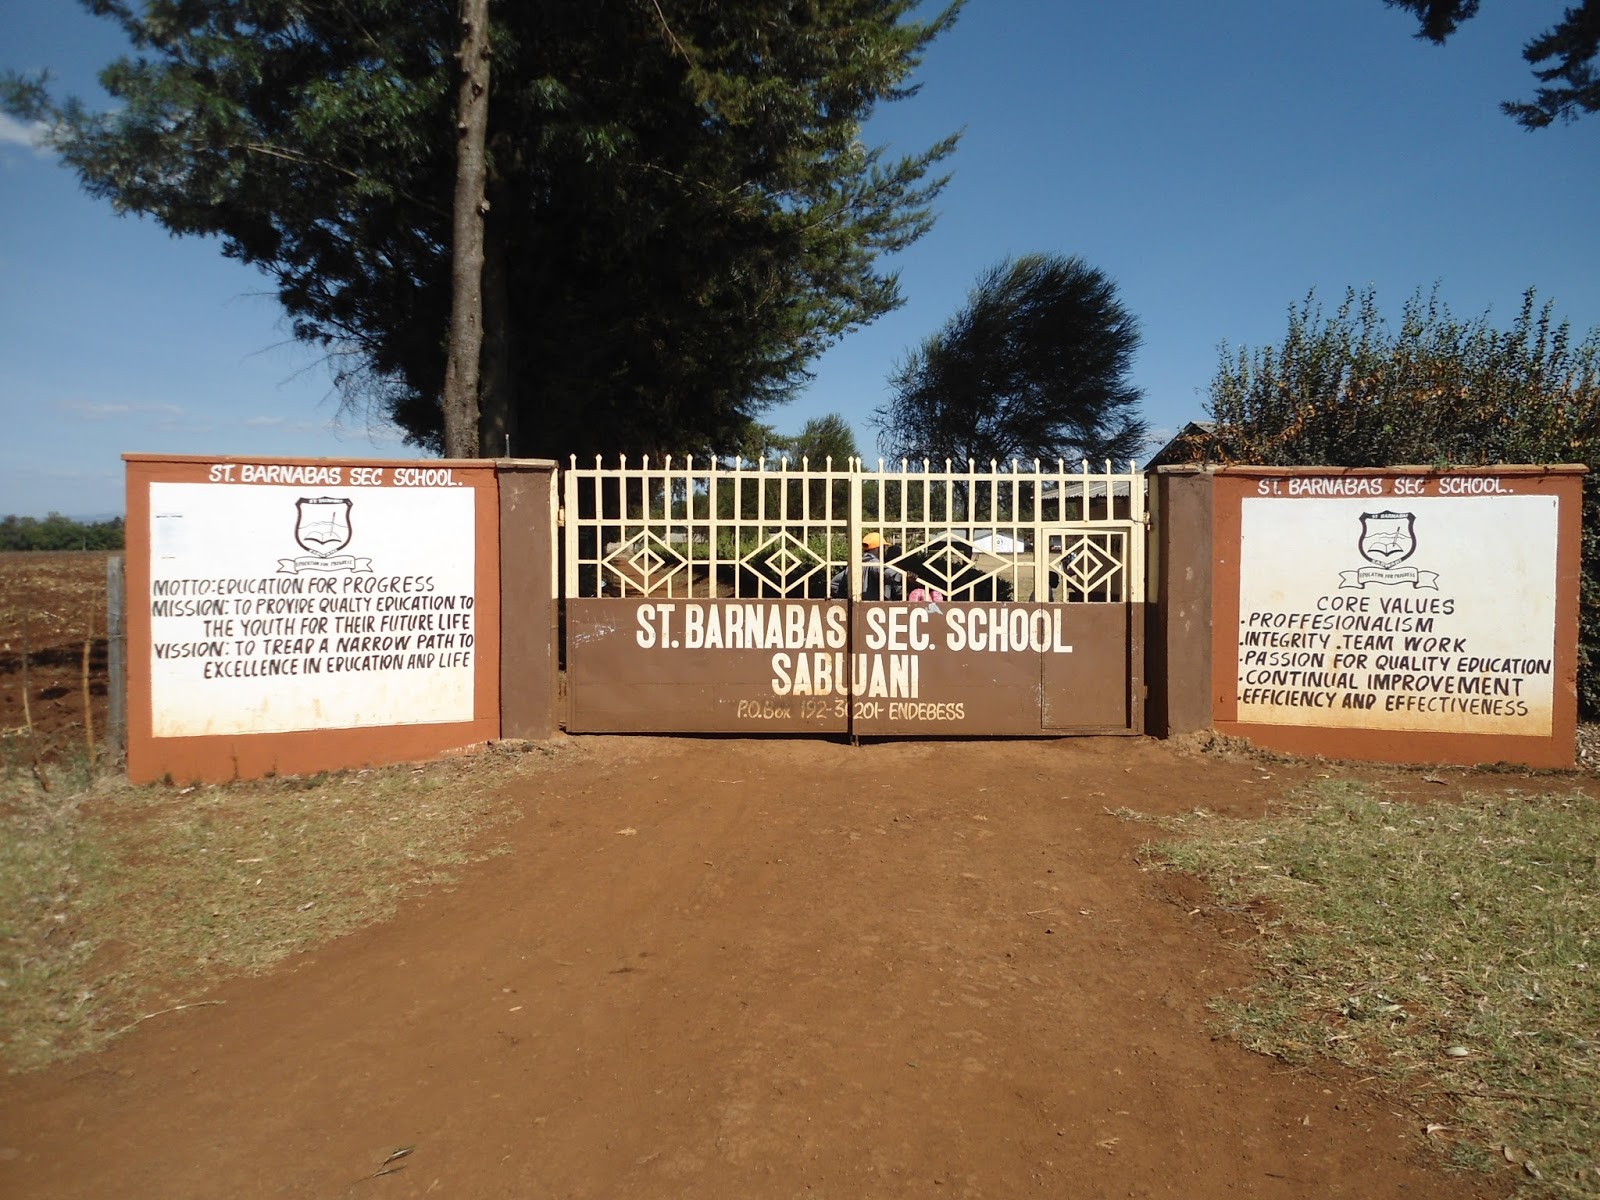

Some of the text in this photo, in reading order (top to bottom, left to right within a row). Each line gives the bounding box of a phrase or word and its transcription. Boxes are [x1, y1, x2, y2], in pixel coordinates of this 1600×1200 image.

[208, 465, 463, 487] ST. BARNABAS SEC SCHOOL.
[1257, 477, 1514, 495] ST. BARNABAS SEC SCHOOL.
[308, 577, 337, 595] FOR
[343, 576, 435, 594] PROGRESS
[152, 595, 474, 617] MISSION: TO PROVIDE QUALTY EDUCATION TO
[1316, 596, 1455, 615] CORE VALUES
[203, 613, 471, 638] THE YOUTH FOR THEIR FUTURE LIFE
[636, 603, 1073, 653] ST. BARNABAS SEC. SCHOOL
[154, 633, 474, 659] VISSION: TO TREAD A NARROW PATH TO
[1244, 631, 1331, 650] INTEGRITY
[1403, 638, 1467, 653] WORK
[203, 651, 471, 679] EXCELLENCE IN EDUCATION AND LIFE
[1245, 650, 1551, 675] PASSION FOR QUALITY EDUCATION
[1246, 669, 1524, 697] CONTINUAL IMPROVEMENT
[888, 702, 966, 721] ENDEBESS
[1242, 688, 1529, 717] EFFICIENCY AND EFFECTIVENESS
